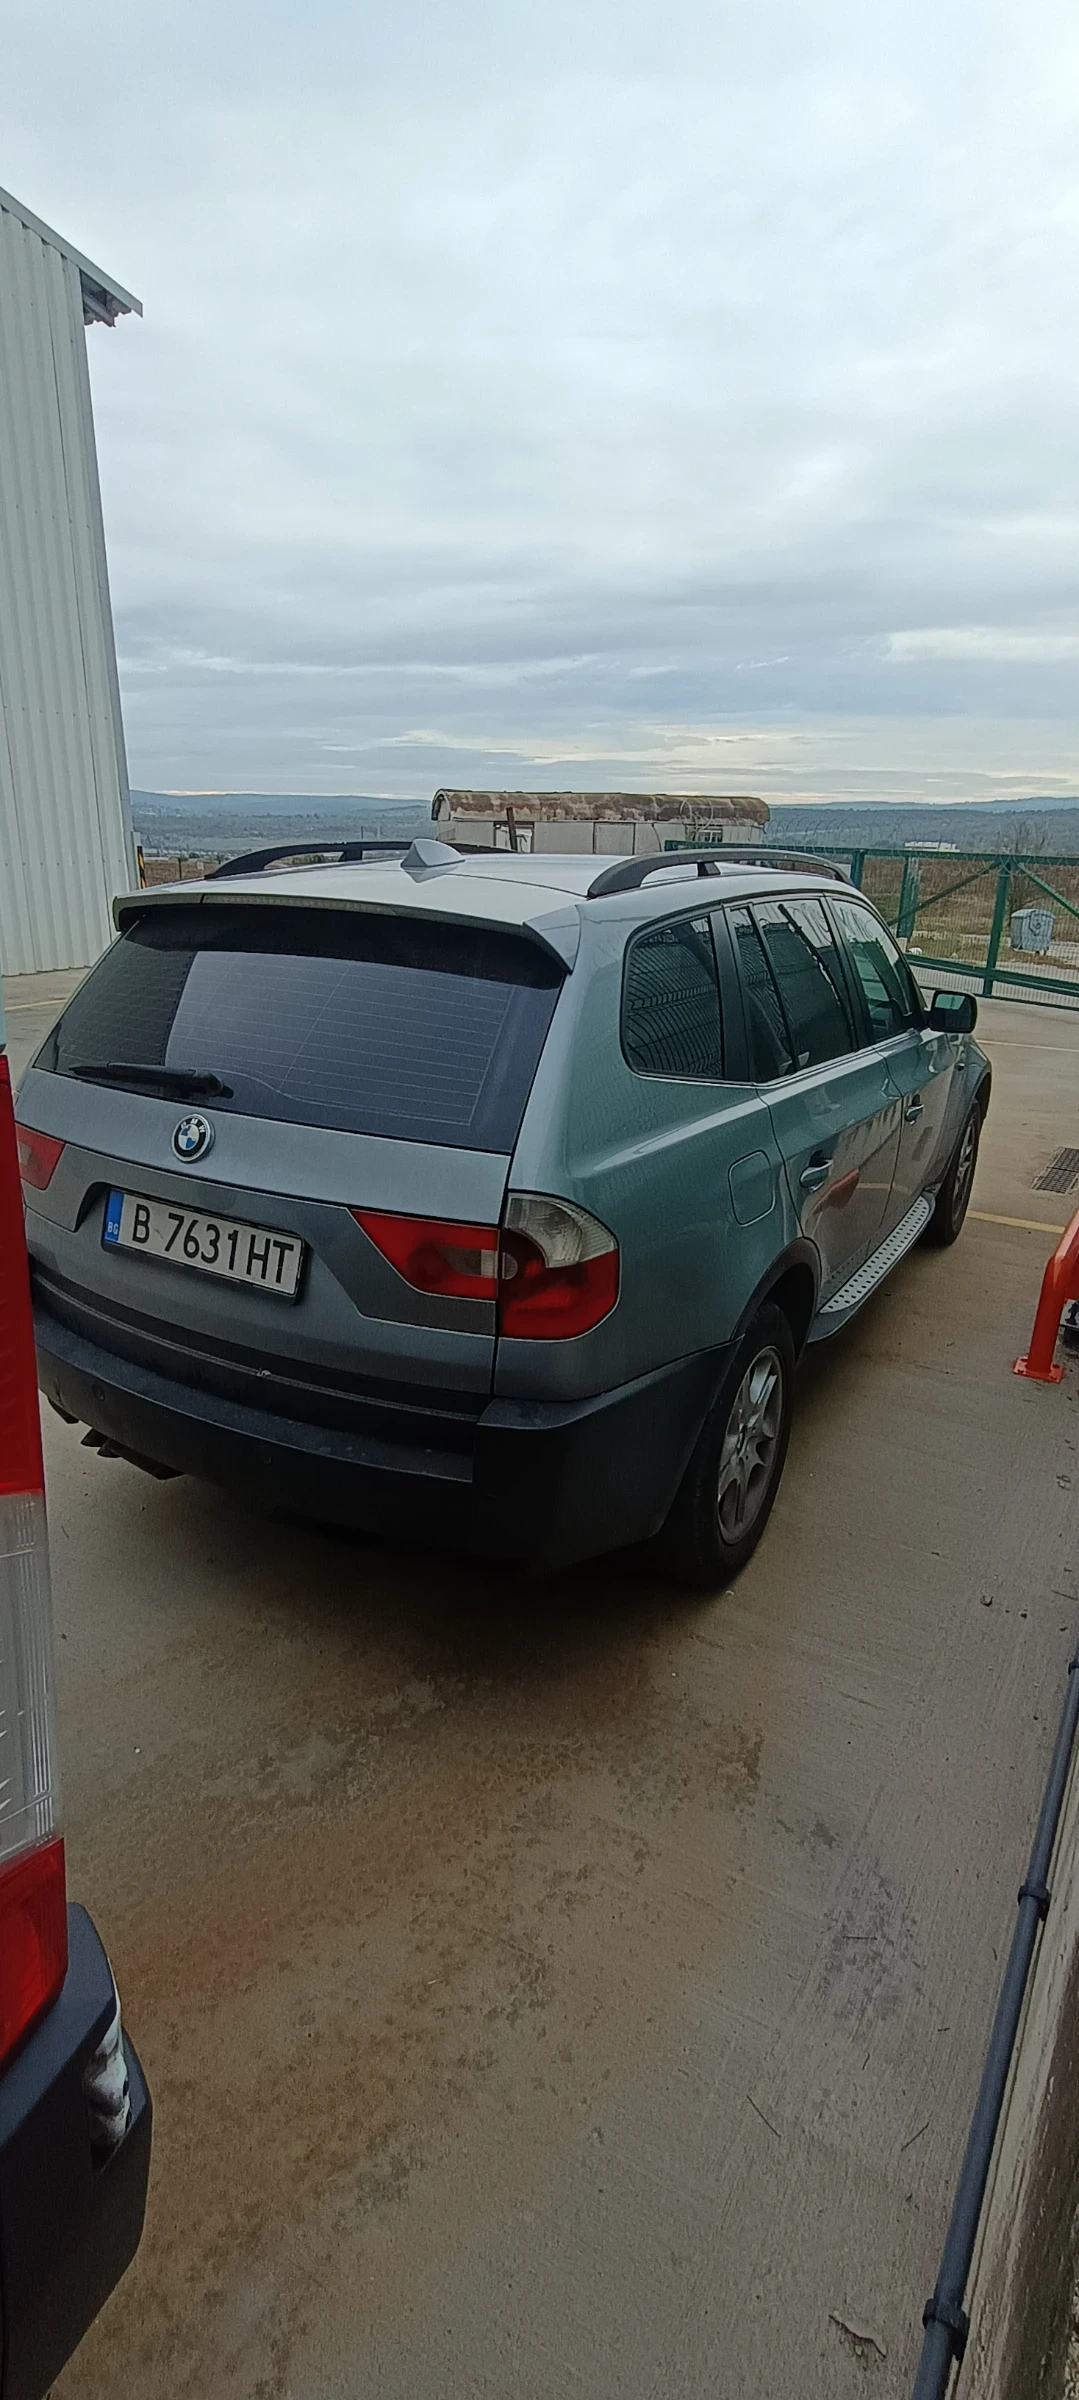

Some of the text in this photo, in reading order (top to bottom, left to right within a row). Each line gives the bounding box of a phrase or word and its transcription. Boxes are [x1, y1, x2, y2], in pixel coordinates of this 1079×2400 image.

[181, 1118, 206, 1133] BMW
[107, 1221, 119, 1235] BG
[132, 1204, 151, 1244] B
